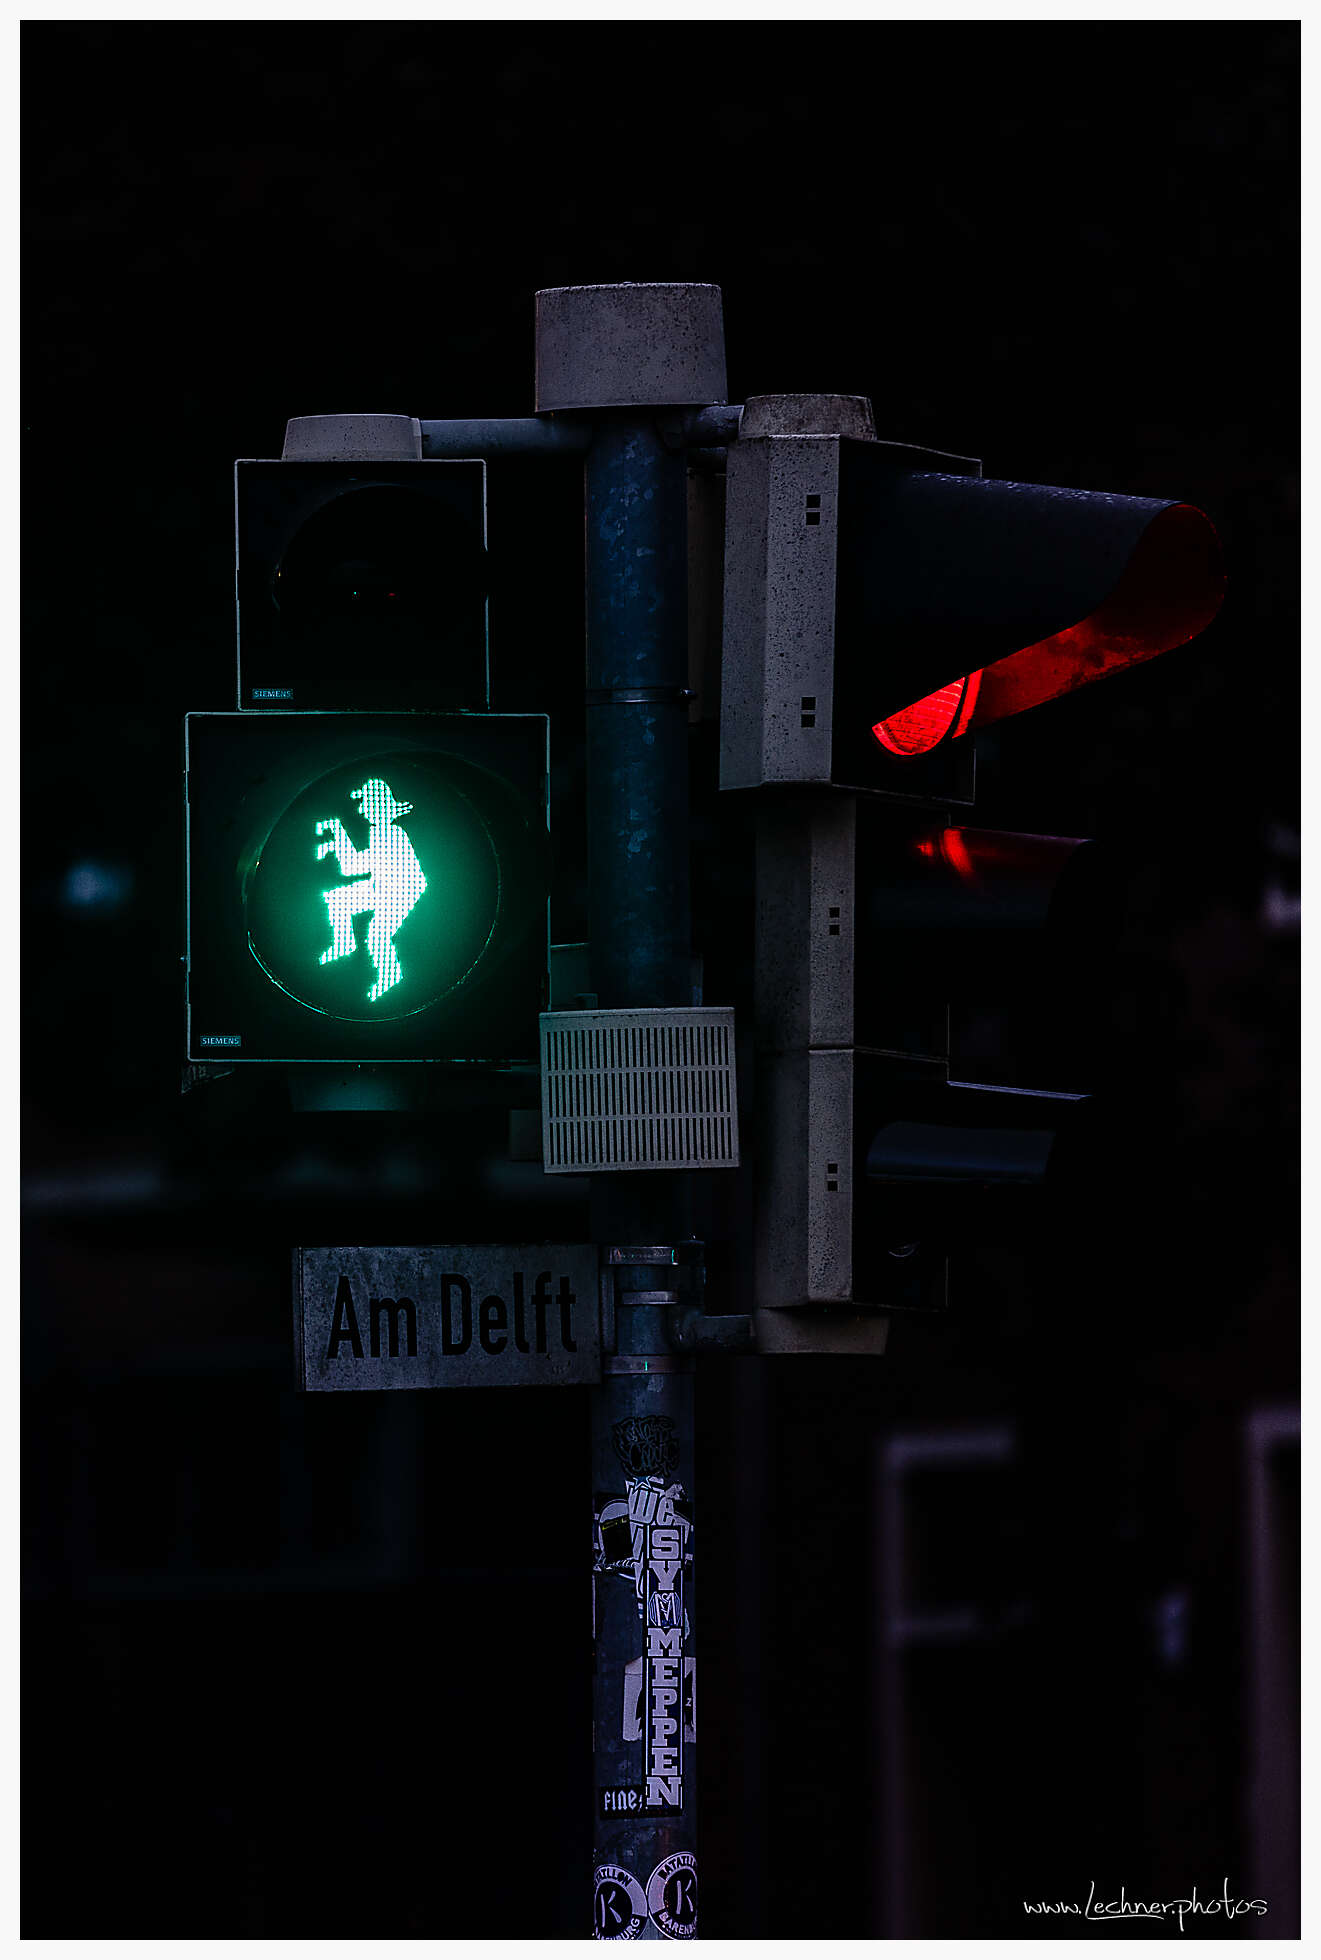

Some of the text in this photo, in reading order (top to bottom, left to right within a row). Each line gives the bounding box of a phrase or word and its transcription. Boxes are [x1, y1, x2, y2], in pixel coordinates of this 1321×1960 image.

[253, 690, 292, 699] SIEMENS
[201, 1037, 240, 1045] SIEMENS
[326, 1270, 578, 1360] Am Delft
[646, 1627, 683, 1806] MEPPEN
[600, 1890, 623, 1928] K
[675, 1878, 694, 1915] K
